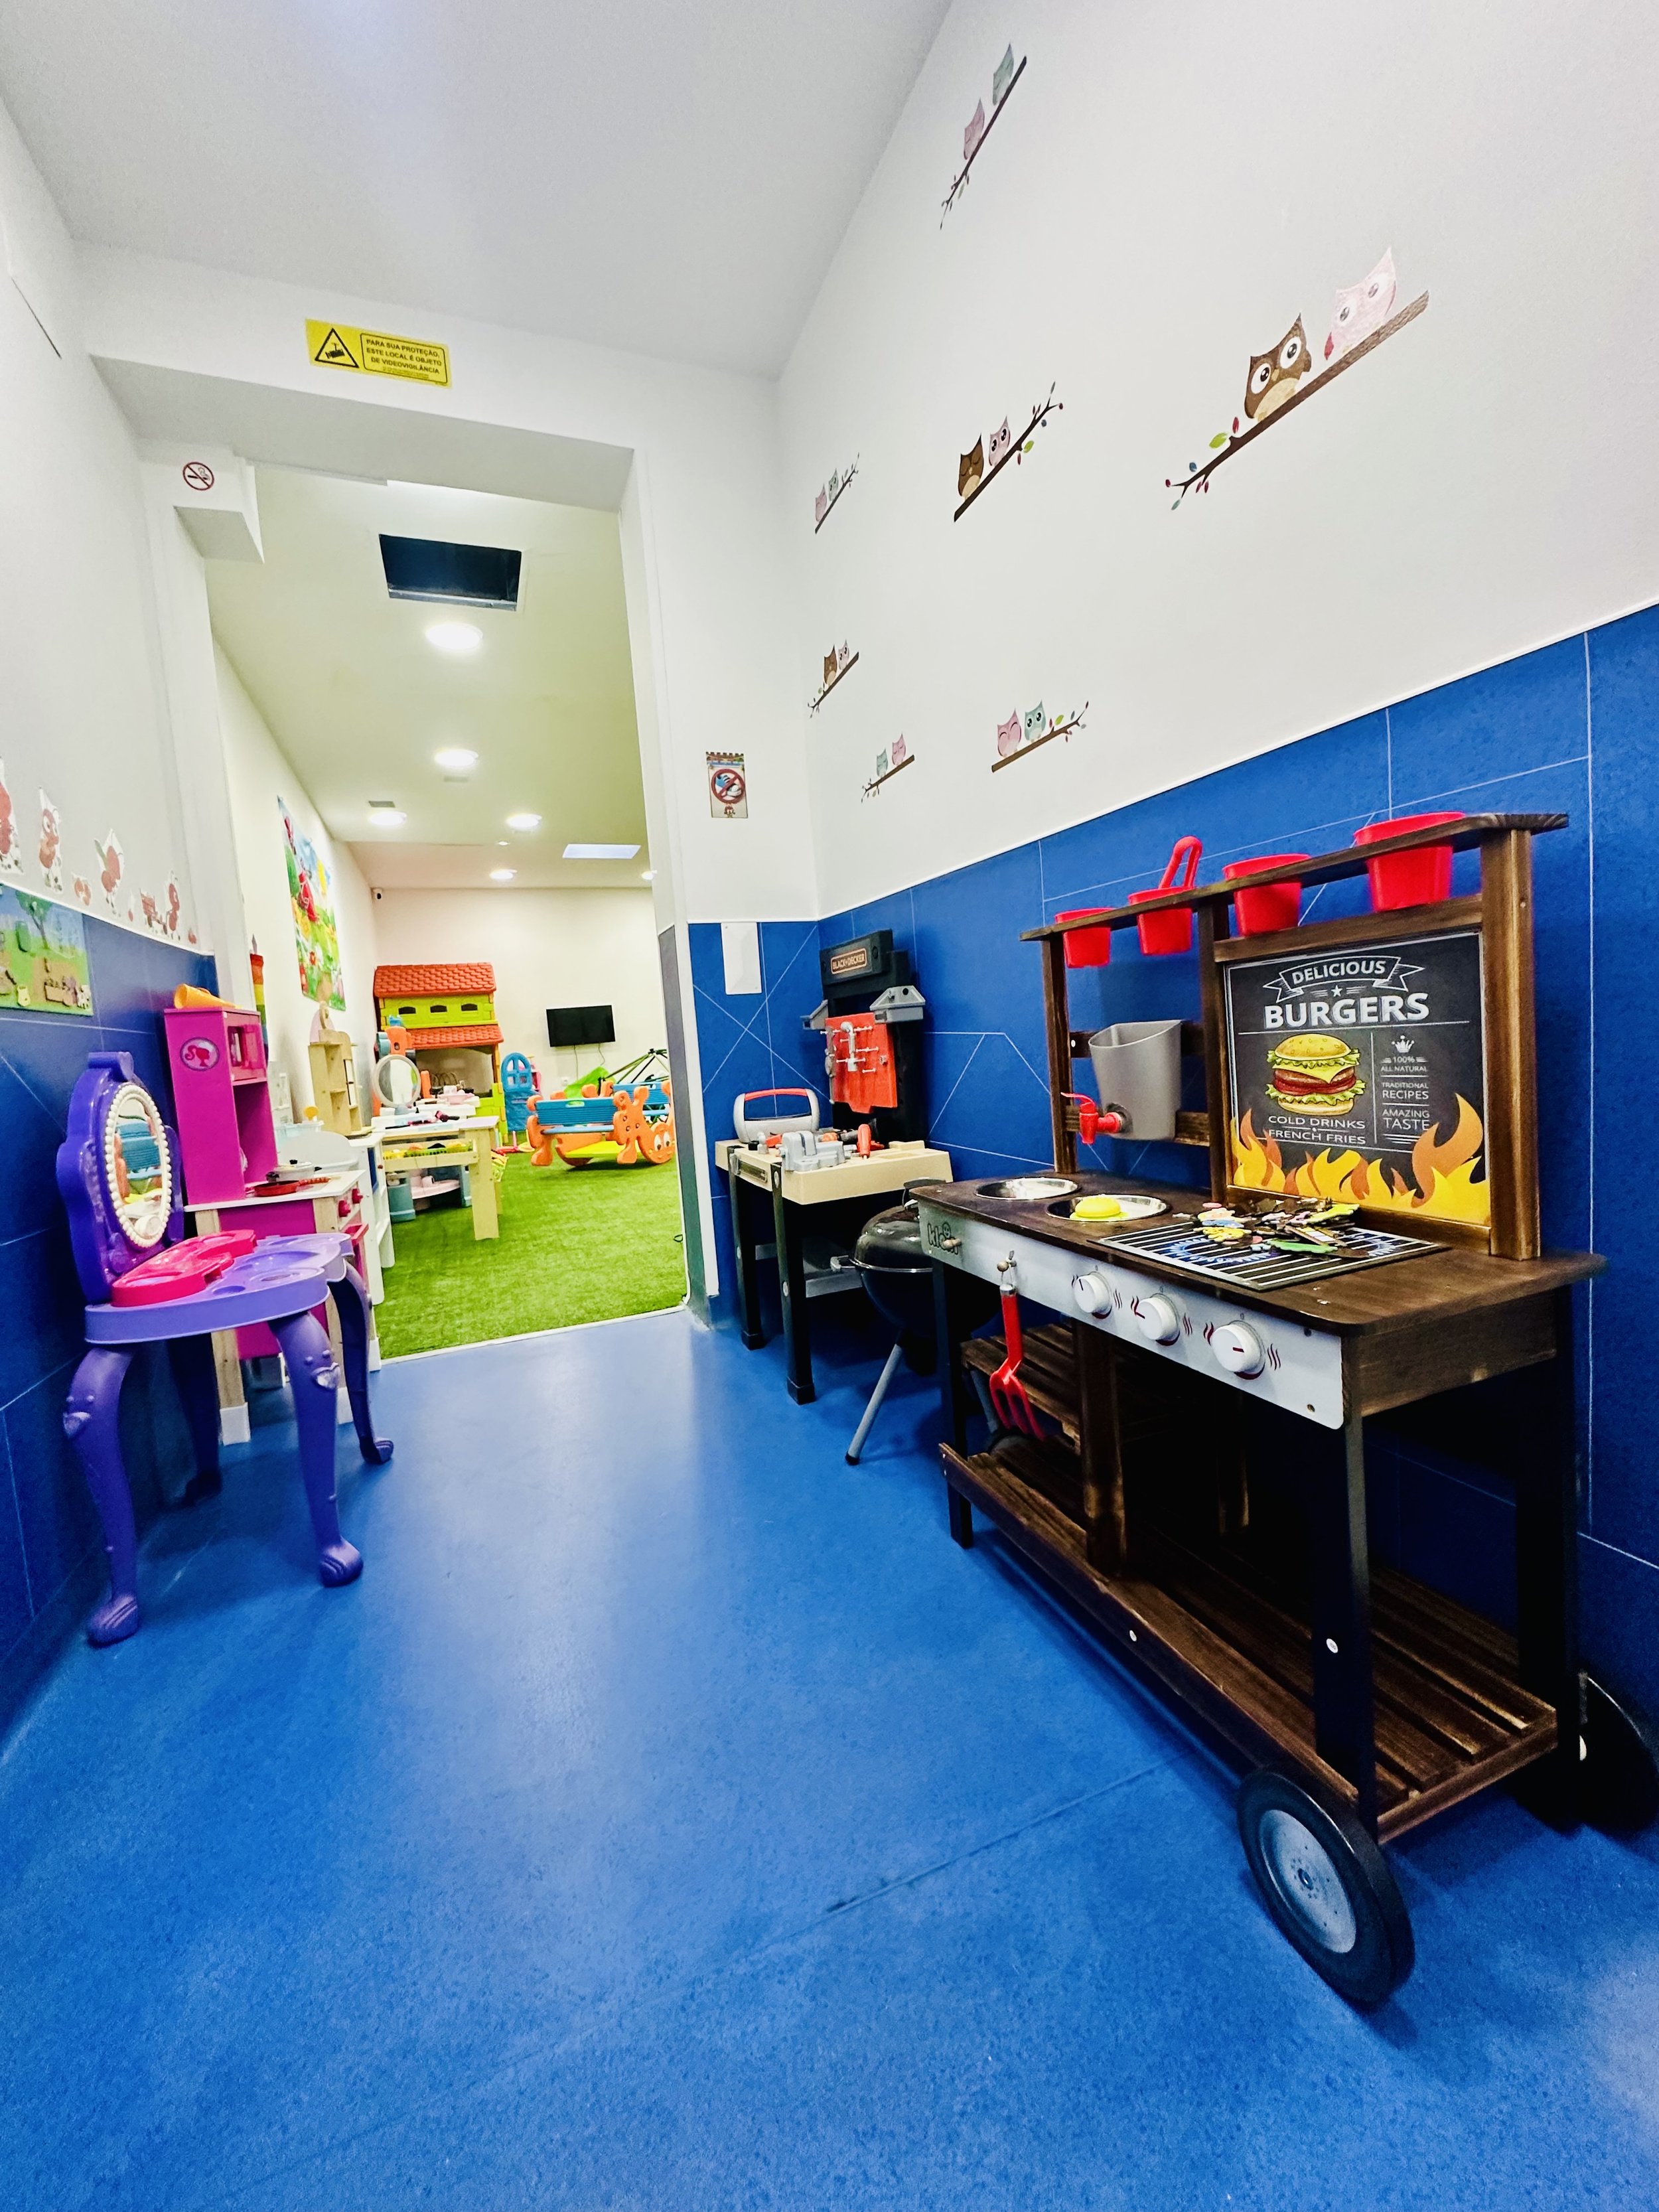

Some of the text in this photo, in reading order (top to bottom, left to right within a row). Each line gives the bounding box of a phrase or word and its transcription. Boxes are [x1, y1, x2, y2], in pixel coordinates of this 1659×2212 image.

[386, 352, 408, 360] LOCAL
[401, 346, 440, 358] PROTEÇÃO,
[382, 358, 440, 374] VIDEOVIGILÂNCIA
[1291, 960, 1386, 985] DELICIOUS
[1264, 993, 1429, 1029] BURGERS
[1382, 1090, 1429, 1100] RECIPES
[1382, 1109, 1429, 1118] AMAZING
[1268, 1116, 1366, 1129] COLD DRINKS
[1383, 1118, 1429, 1131] TASTE
[1269, 1130, 1366, 1144] FRENCH FRIES
